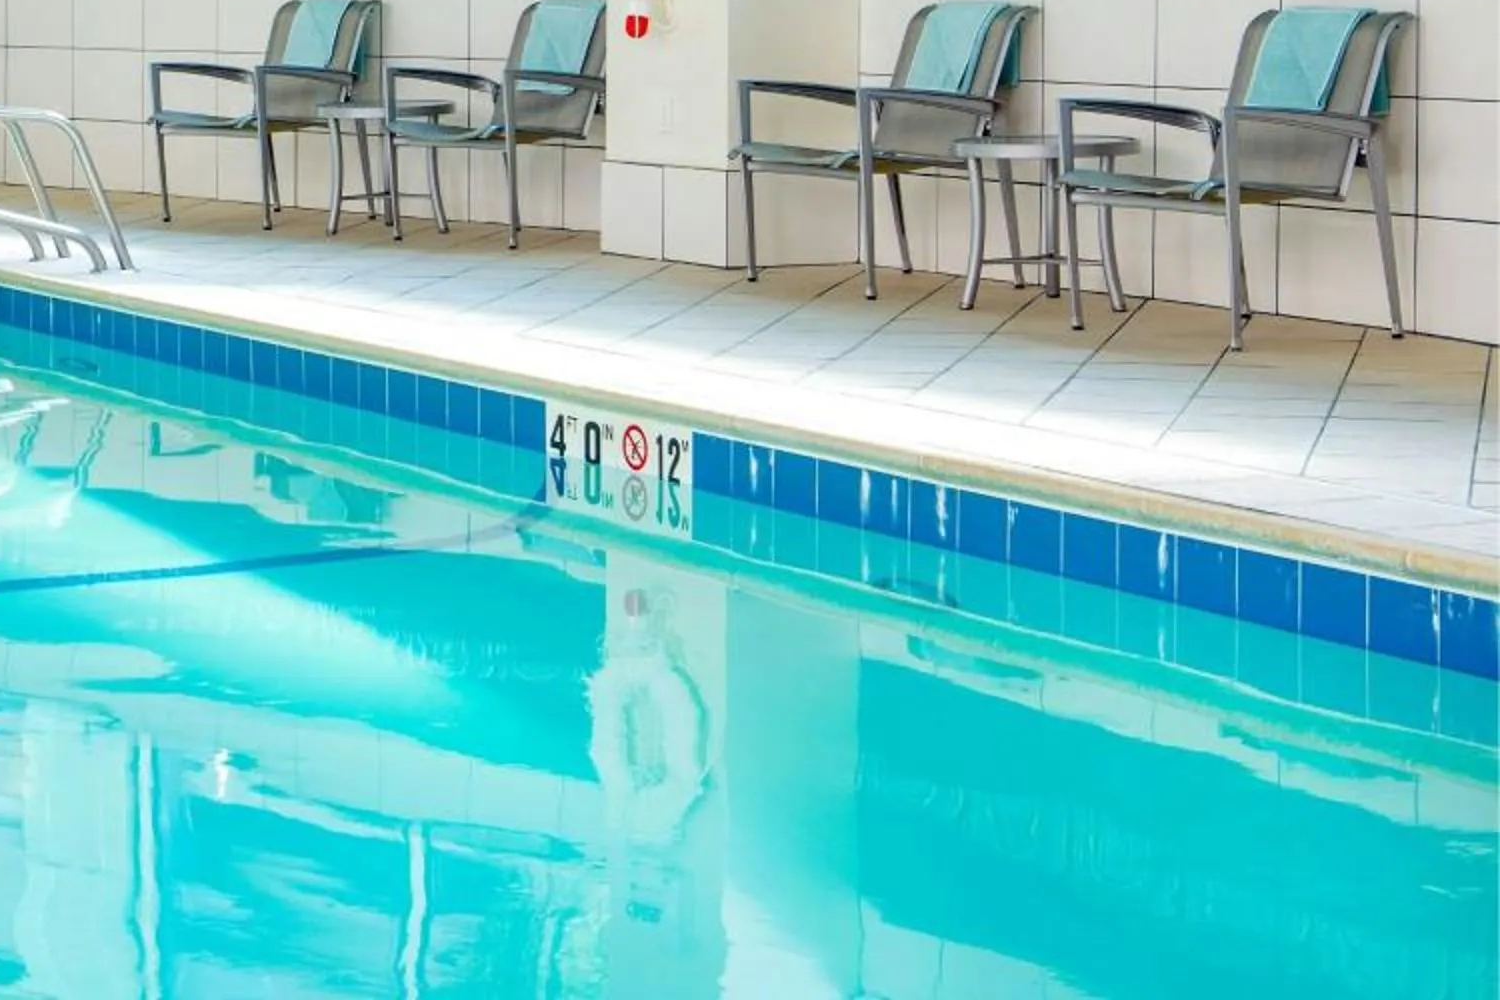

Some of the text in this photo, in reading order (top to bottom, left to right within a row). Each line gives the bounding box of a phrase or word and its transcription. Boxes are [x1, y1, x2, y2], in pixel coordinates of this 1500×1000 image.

[550, 414, 566, 457] 4
[567, 415, 579, 432] FT
[584, 421, 600, 464] 0
[602, 424, 614, 441] IN
[656, 434, 680, 485] 12
